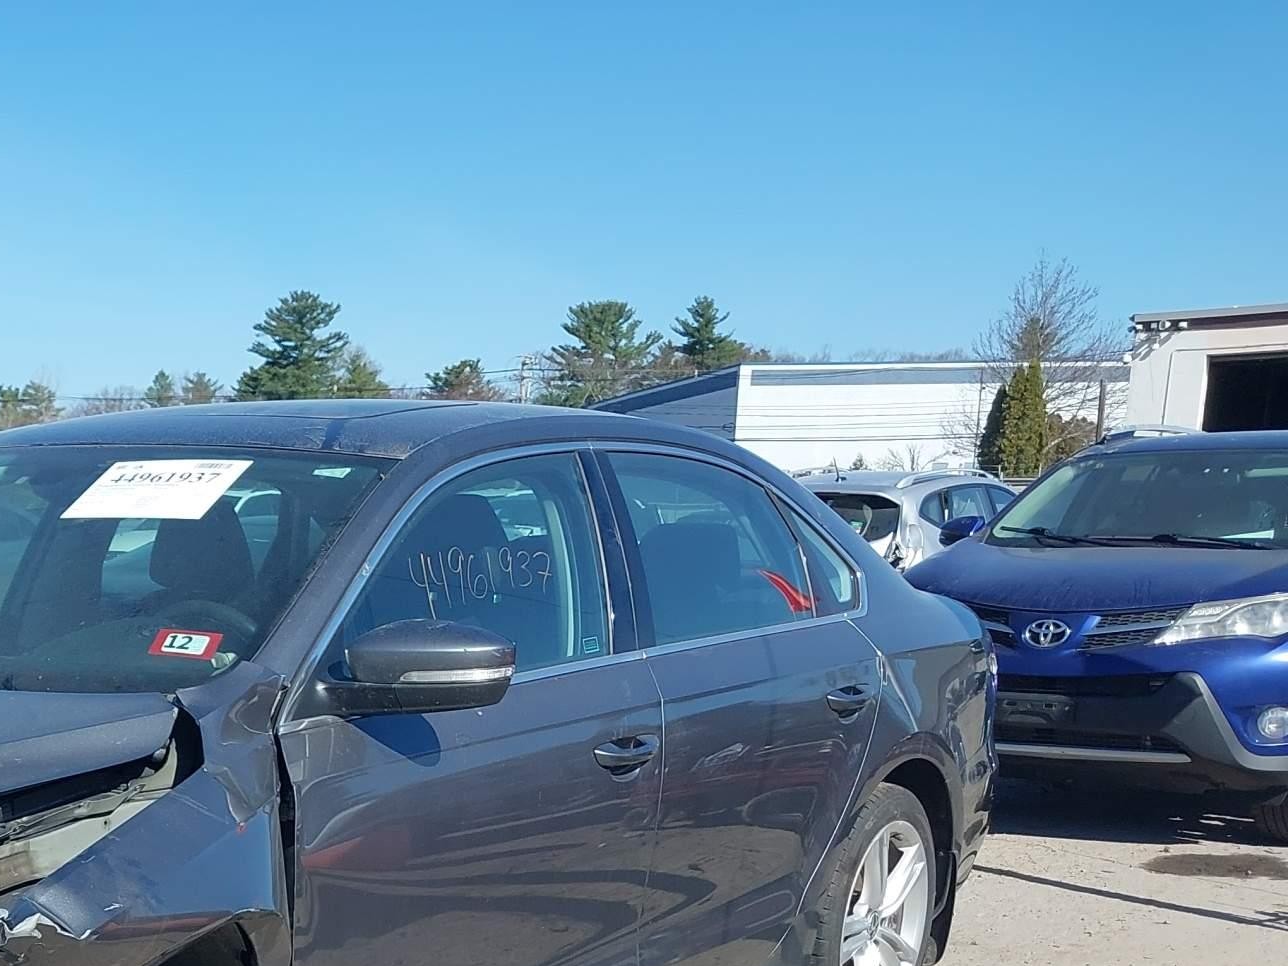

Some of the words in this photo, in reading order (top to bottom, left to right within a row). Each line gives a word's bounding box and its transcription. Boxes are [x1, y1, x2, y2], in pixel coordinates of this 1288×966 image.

[111, 472, 222, 484] 44961937
[408, 546, 552, 620] 44961937
[164, 634, 193, 650] 12
